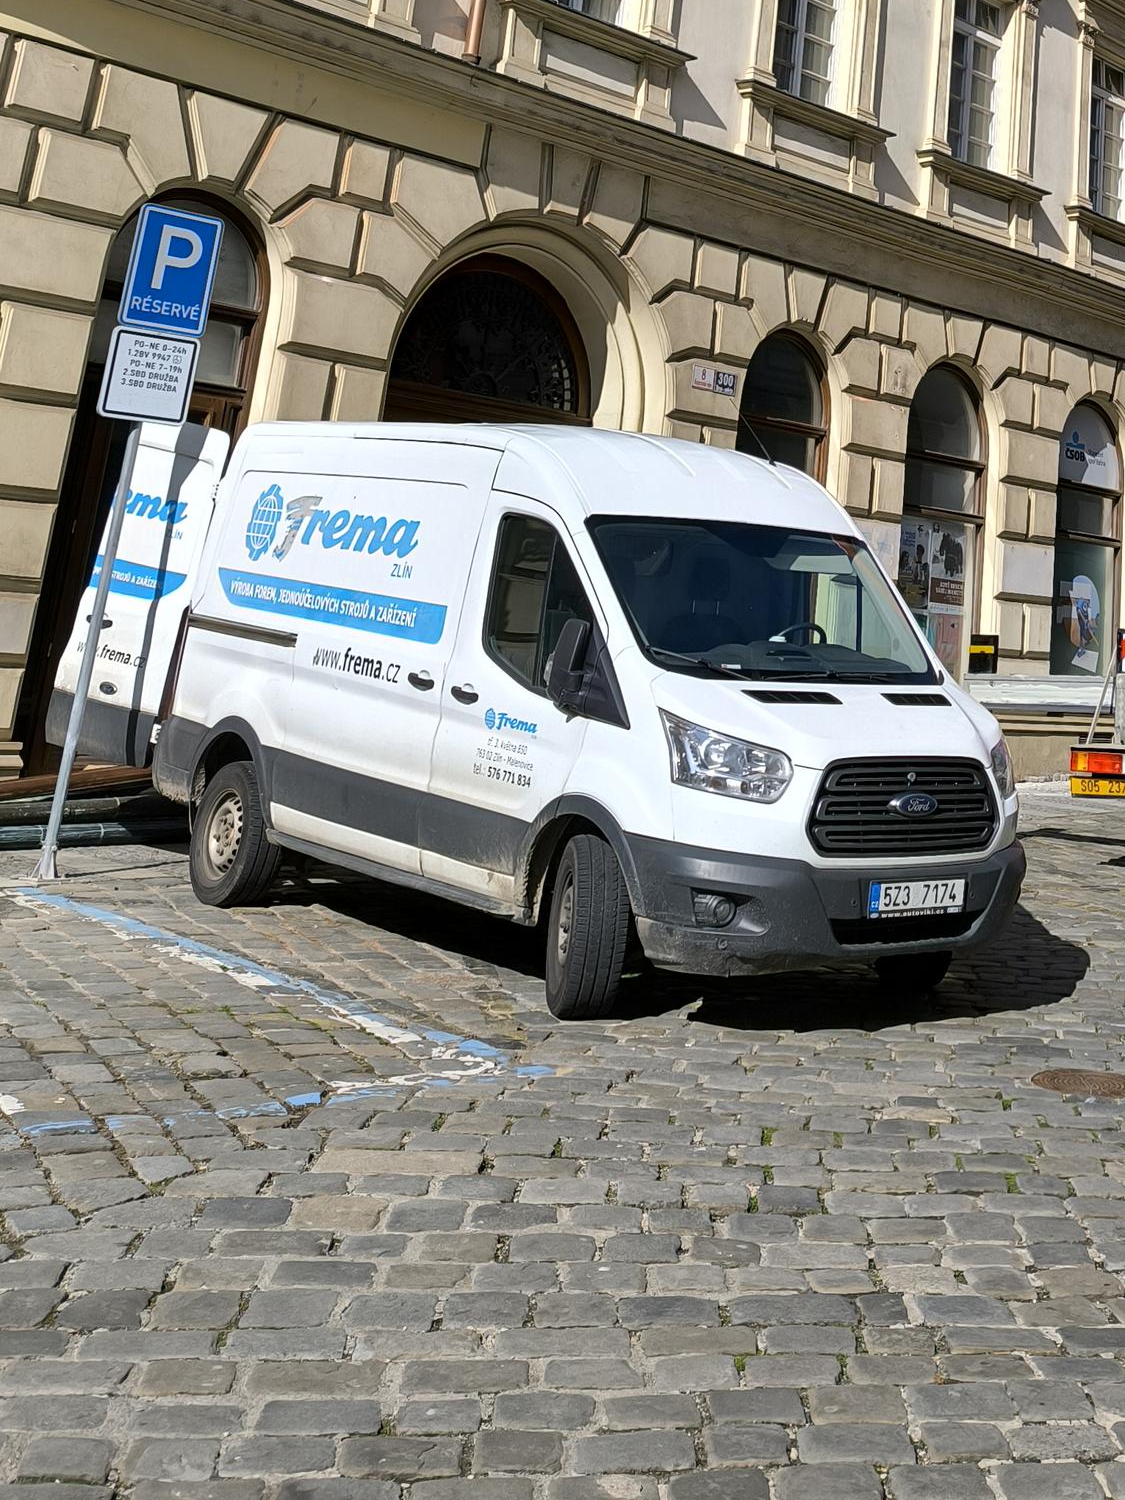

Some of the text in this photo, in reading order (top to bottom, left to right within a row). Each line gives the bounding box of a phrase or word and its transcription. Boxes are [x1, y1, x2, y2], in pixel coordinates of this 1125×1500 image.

[151, 224, 203, 290] P
[130, 295, 200, 321] RÉSERVÉ
[152, 353, 171, 362] 9947
[148, 372, 179, 383] DRUŽBA
[158, 364, 183, 374] 7-19h
[701, 369, 707, 380] 8
[146, 381, 177, 393] DRUŽBA
[718, 373, 734, 387] 300
[1065, 448, 1086, 462] ČSOB
[272, 495, 420, 563] Frema
[390, 562, 413, 579] ZLÍN
[230, 577, 417, 628] VÝROBA FOREM, JEDNOÚČELOVÝCH STROJŮ A ZAŘÍZENÍ
[312, 647, 401, 684] www.frema.cz
[496, 712, 538, 733] Frema
[487, 766, 501, 780] 576
[502, 769, 515, 784] 771
[517, 774, 531, 788] 834
[907, 797, 930, 812] Ford
[884, 883, 957, 907] 5Z3 7174
